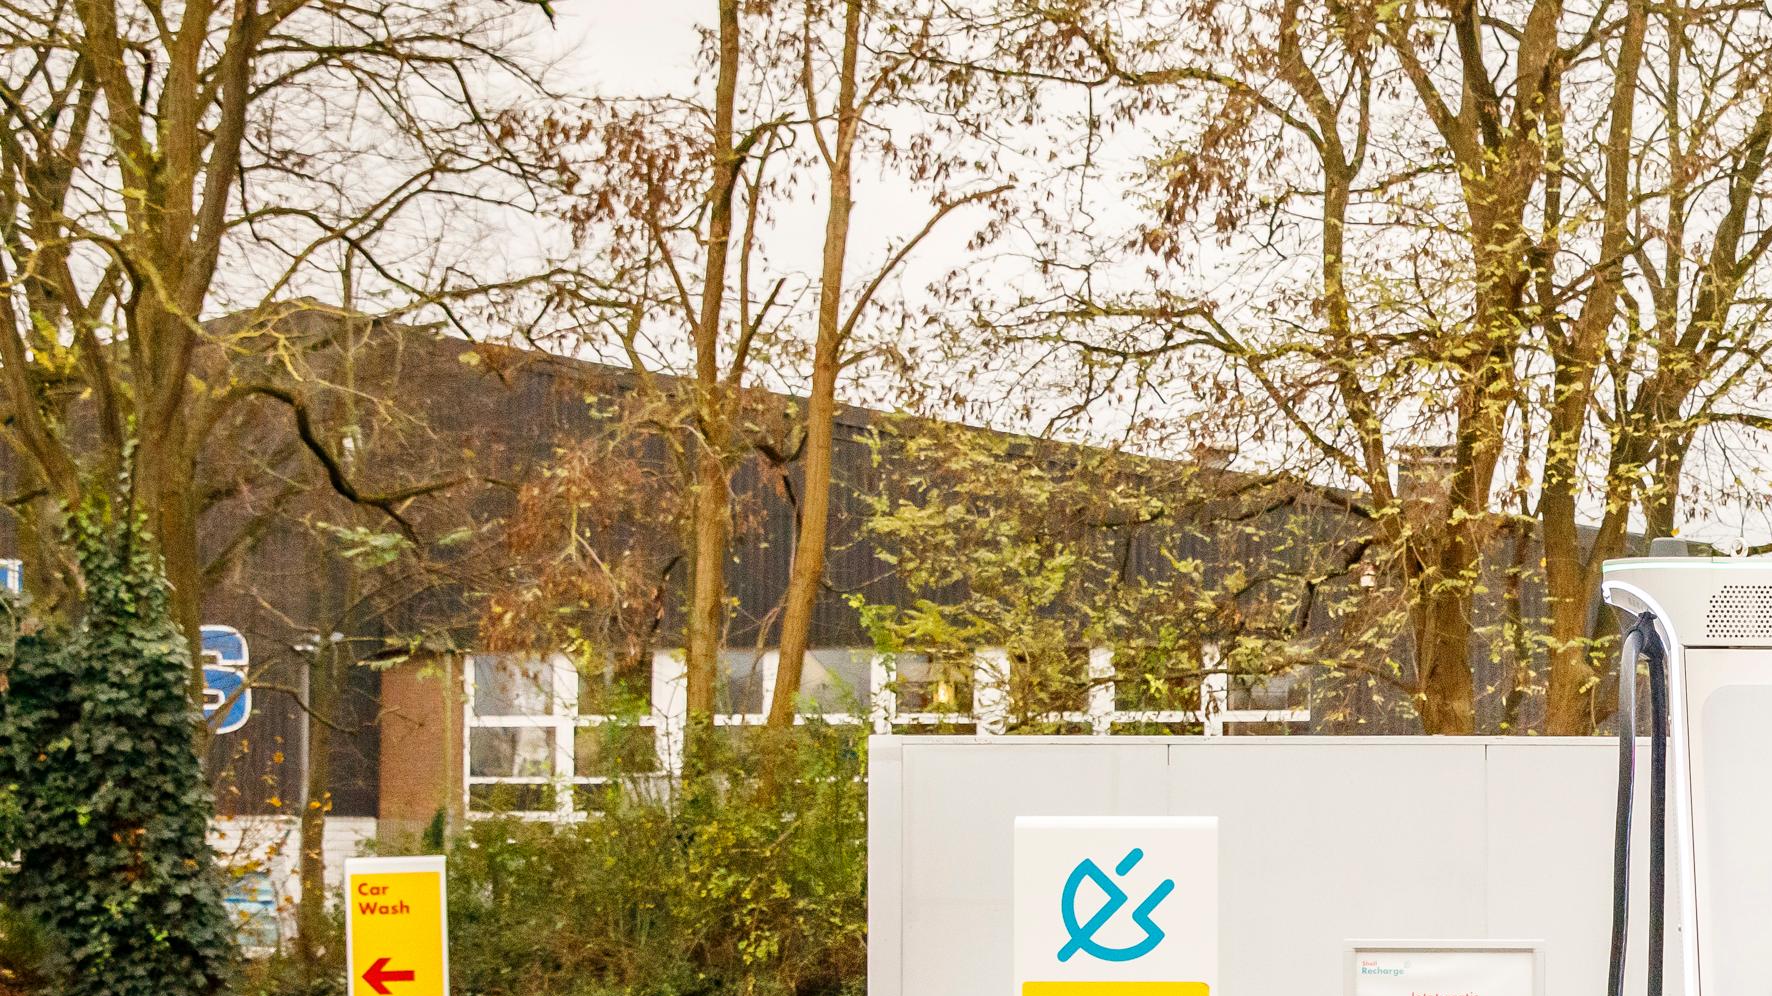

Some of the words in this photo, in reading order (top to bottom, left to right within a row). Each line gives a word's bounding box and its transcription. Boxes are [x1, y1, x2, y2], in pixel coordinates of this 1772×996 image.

[358, 882, 389, 897] Car
[358, 900, 410, 916] Wash
[1361, 967, 1404, 976] Recharge
